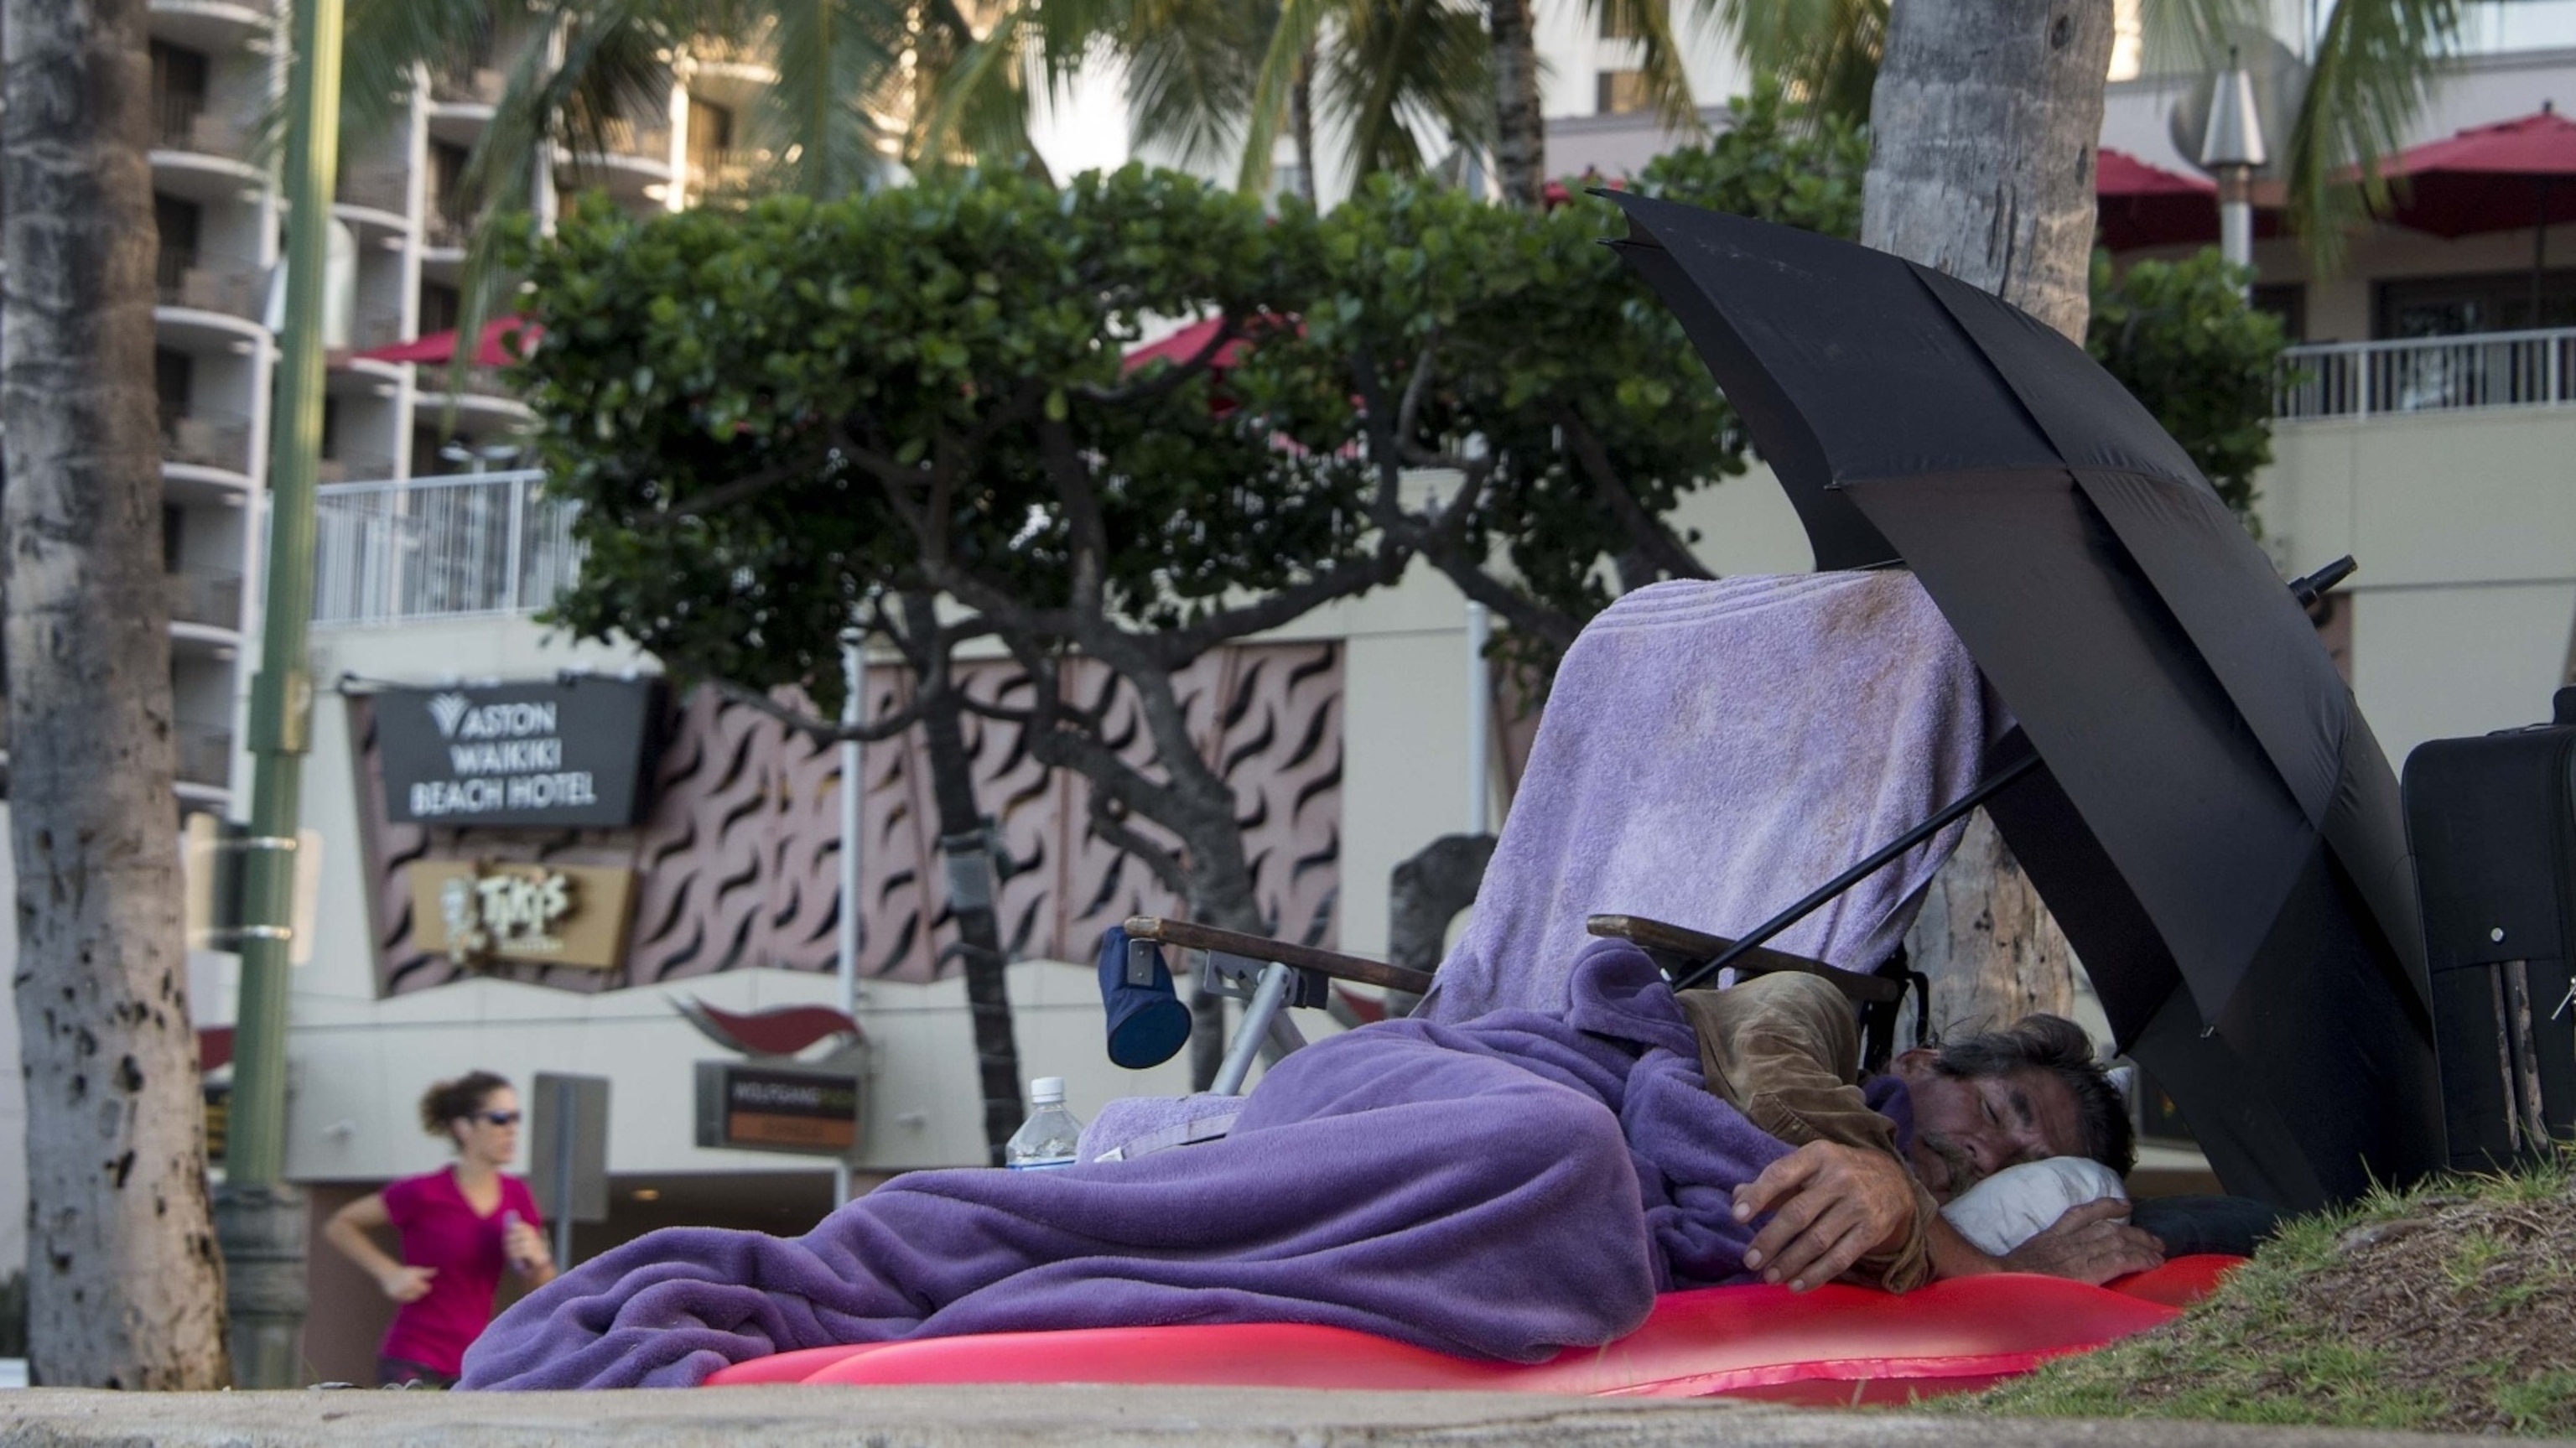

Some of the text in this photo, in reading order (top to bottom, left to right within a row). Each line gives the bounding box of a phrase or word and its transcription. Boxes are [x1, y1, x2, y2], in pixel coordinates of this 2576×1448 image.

[460, 702, 558, 739] ASTON
[449, 738, 562, 775] WAIKIKI
[410, 771, 597, 817] BEACH HOTEL
